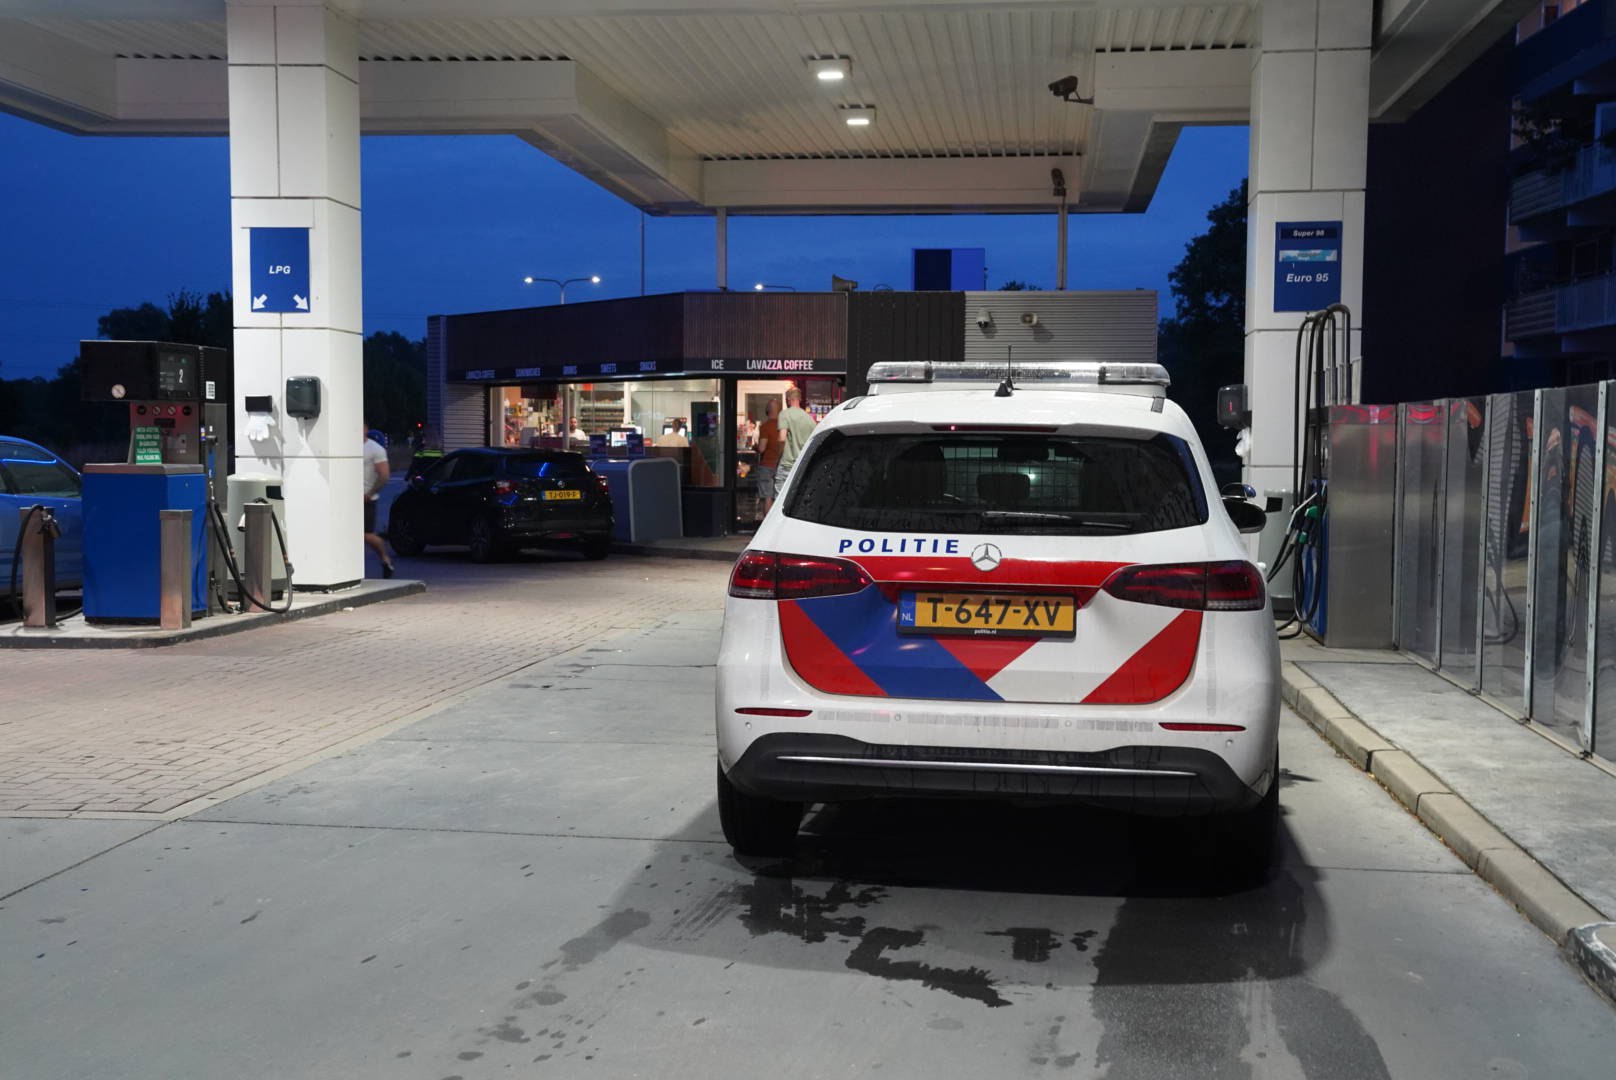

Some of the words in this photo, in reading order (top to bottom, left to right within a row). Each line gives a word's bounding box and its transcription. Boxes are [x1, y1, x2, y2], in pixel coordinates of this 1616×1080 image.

[1293, 229, 1314, 238] Super
[269, 265, 291, 274] LPG
[1286, 273, 1313, 283] Euro
[1316, 273, 1329, 282] 95
[711, 359, 724, 370] ICE
[746, 359, 783, 370] LAVAZZA
[784, 359, 814, 370] COFFEE
[179, 368, 184, 384] 2
[838, 538, 960, 554] POLITIE
[902, 612, 914, 622] NL
[927, 597, 1062, 626] T-647-XV
